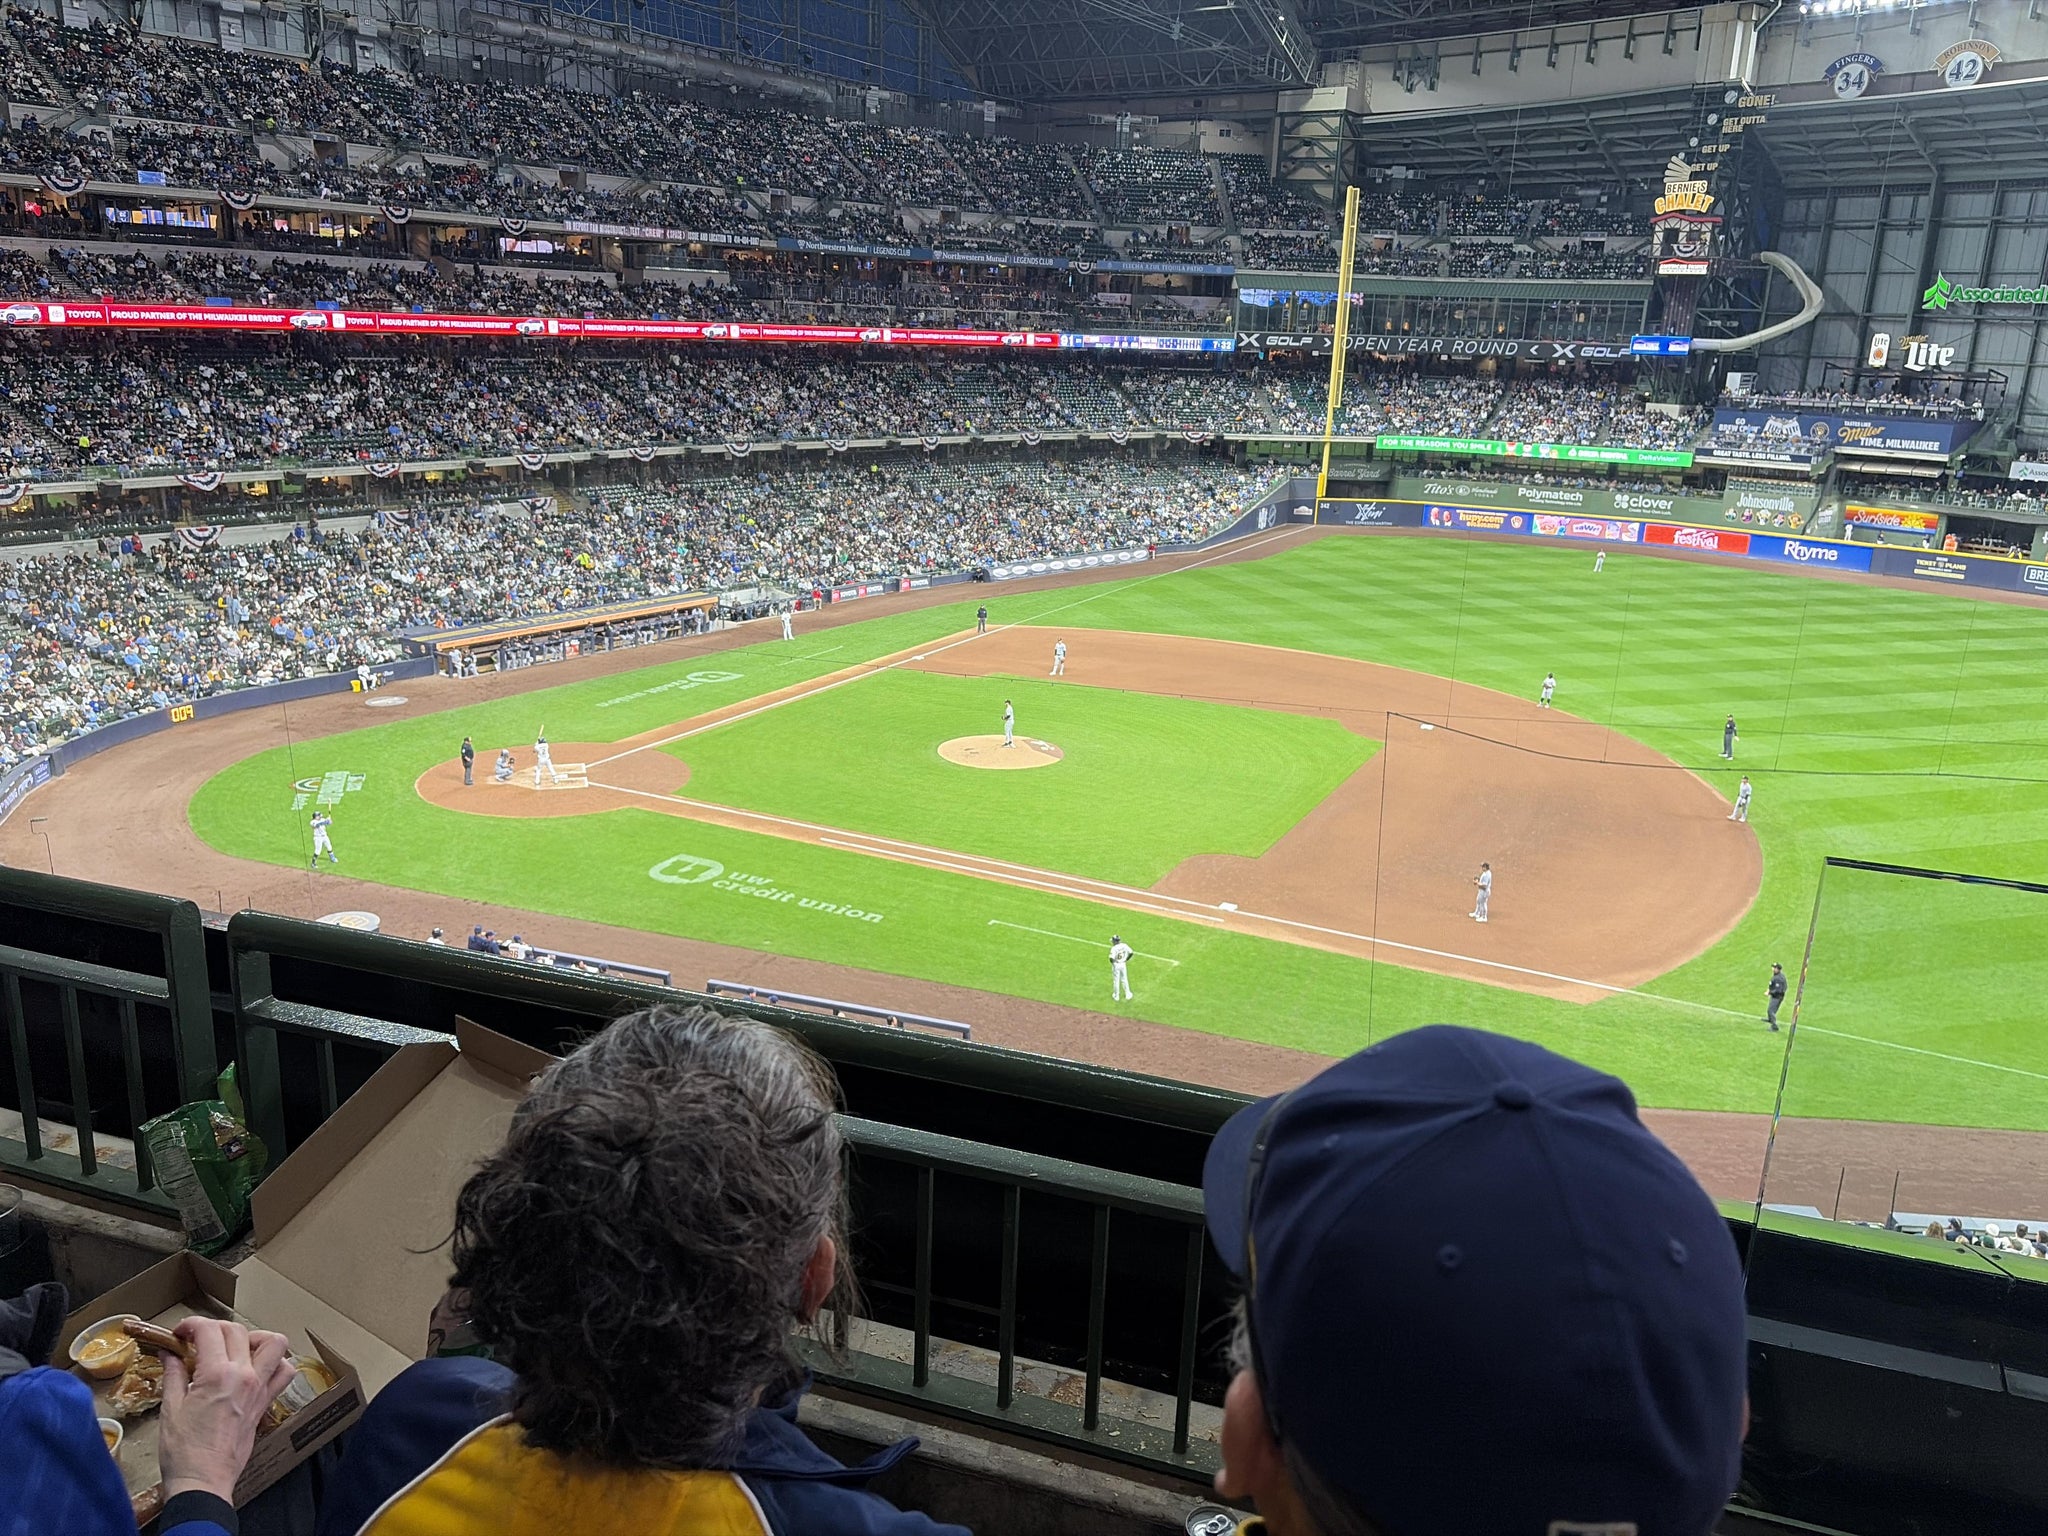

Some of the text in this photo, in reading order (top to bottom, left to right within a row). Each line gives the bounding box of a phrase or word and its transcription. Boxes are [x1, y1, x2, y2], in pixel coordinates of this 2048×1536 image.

[1943, 42, 1991, 59] ROBINSON
[1835, 53, 1876, 69] FINGERS
[1948, 58, 1980, 82] 42
[1837, 70, 1866, 93] 34
[1738, 94, 1776, 108] GONE!
[1723, 115, 1766, 126] GET OUTTA
[1722, 124, 1744, 133] HERE
[1702, 143, 1731, 153] GET UP
[1690, 162, 1718, 172] GET UP
[1666, 181, 1707, 193] BERNIE'S
[1655, 192, 1714, 215] CHALET
[806, 242, 911, 256] Northwestern Mutual LEGENDS CLUB
[942, 252, 1053, 266] Northwestern Mutual LEGENDS CLUB
[1950, 283, 2046, 304] Associated
[67, 310, 103, 319] TOYOTA
[111, 311, 139, 320] PROUD
[140, 312, 175, 320] PARTNER
[176, 312, 188, 320] OF
[189, 313, 202, 321] THE
[204, 313, 247, 322] MILWAUKEE
[347, 317, 374, 326] TOYOTA
[380, 318, 402, 326] PROUD
[403, 318, 429, 327] PARTNER
[1238, 333, 1314, 347] X GOLF
[1342, 337, 1518, 356] OPEN YEAR ROUND
[1898, 335, 1929, 350] Miller
[1552, 343, 1577, 358] X
[1580, 346, 1631, 358] GOLF
[1904, 341, 1954, 372] Lite
[1718, 424, 1739, 432] BREW
[1735, 417, 1746, 425] GO
[1838, 426, 1886, 443] Miller
[1383, 438, 1398, 446] FOR
[1400, 439, 1414, 447] THE
[1416, 440, 1450, 448] REASONS
[1452, 441, 1468, 449] YOU
[1860, 437, 1940, 451] TIME, MILWAUKEE
[1713, 449, 1731, 457] GREAT
[1752, 452, 1766, 460] LESS
[1424, 483, 1455, 496] Tito's
[1518, 487, 1583, 501] Polymatech
[1629, 495, 1674, 510] clover
[1737, 492, 1794, 512] Johnsonville
[1853, 510, 1900, 527] Surfside
[1673, 529, 1719, 549] festival
[1784, 540, 1838, 561] Rhyme
[1916, 559, 1937, 567] TICKET
[171, 704, 194, 722] 009
[728, 871, 774, 886] uw
[712, 879, 884, 924] credit union
